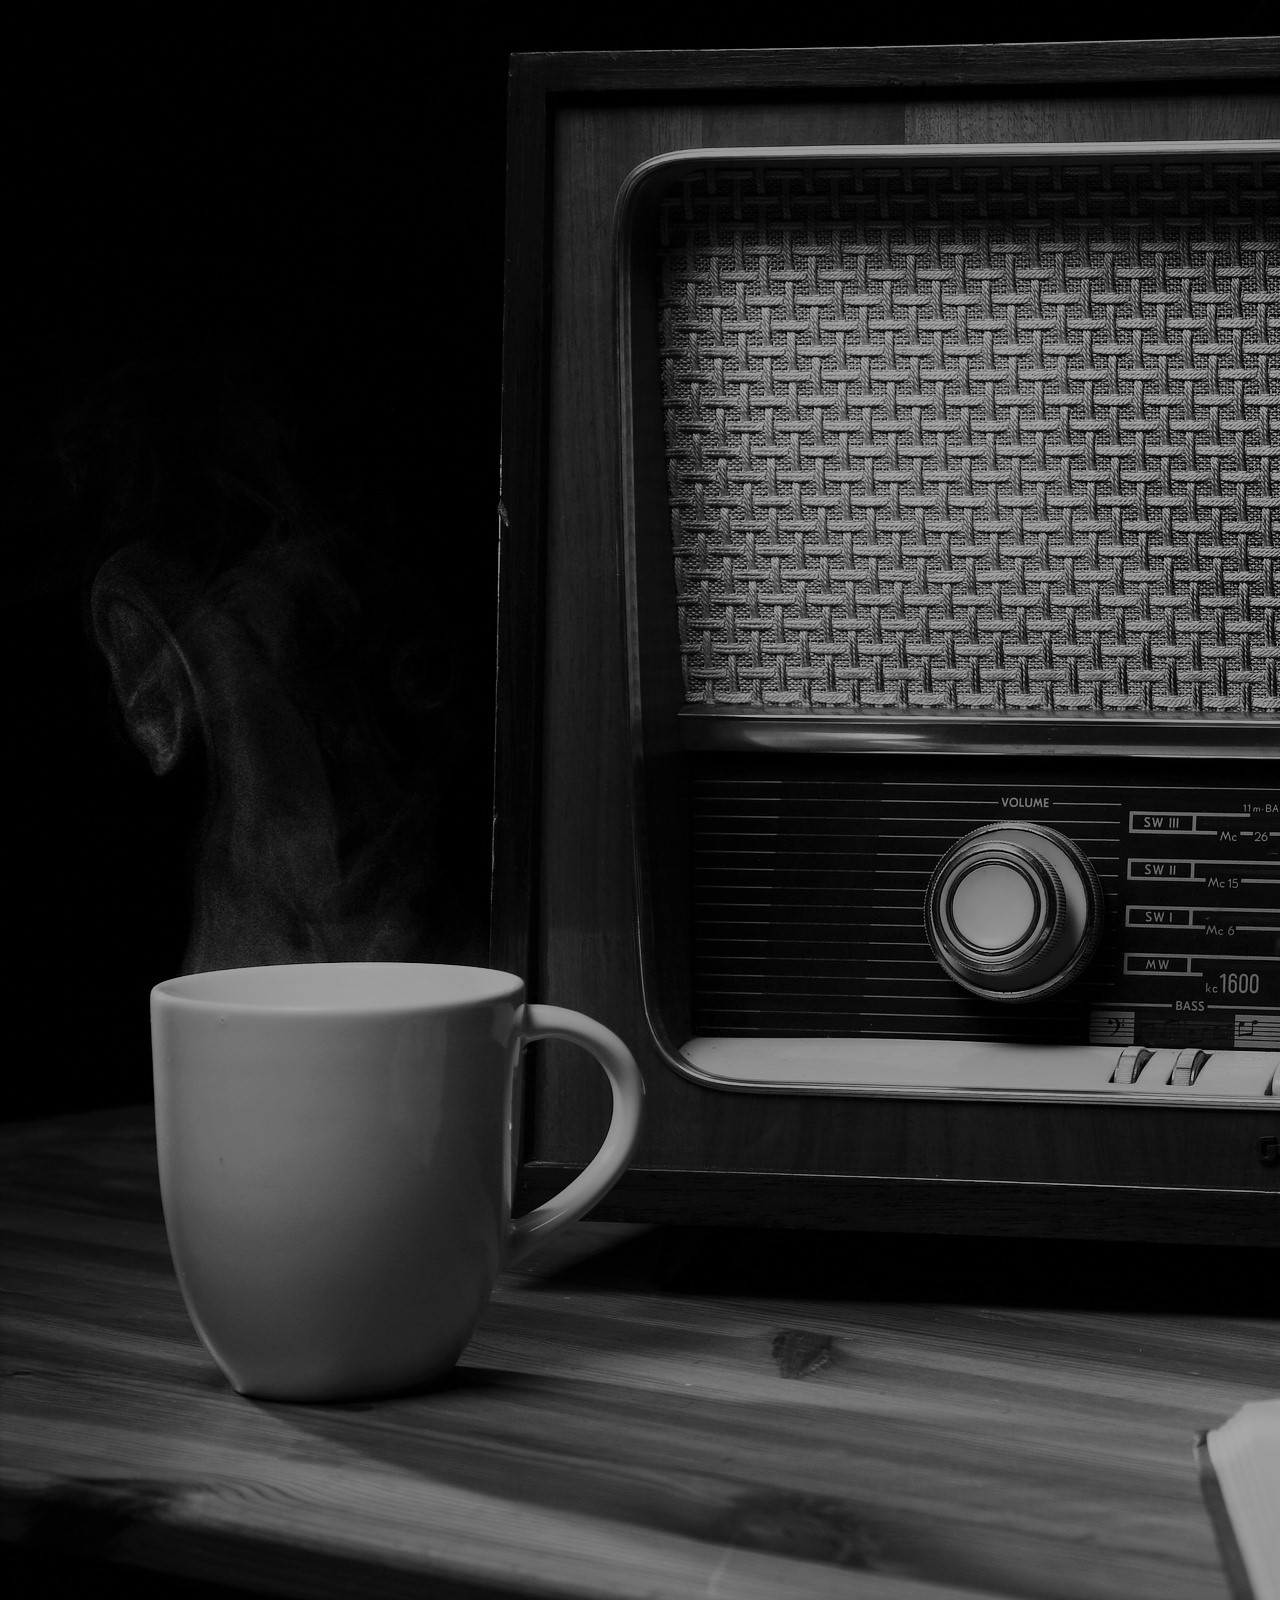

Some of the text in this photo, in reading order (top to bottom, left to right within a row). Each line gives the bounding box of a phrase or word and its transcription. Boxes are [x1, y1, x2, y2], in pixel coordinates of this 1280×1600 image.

[1001, 797, 1050, 808] VOLUME
[1143, 816, 1180, 829] SW III
[1219, 830, 1238, 842] Mc
[1254, 831, 1269, 842] 26
[1144, 863, 1165, 876] SW
[1207, 877, 1226, 889] Mc
[1227, 878, 1239, 889] 15
[1145, 911, 1165, 923] SW
[1205, 924, 1224, 936] Mc
[1227, 925, 1235, 936] 6
[1145, 959, 1170, 970] MW
[1205, 982, 1219, 994] kc
[1219, 972, 1260, 994] 1600
[1175, 1000, 1205, 1012] BASS
